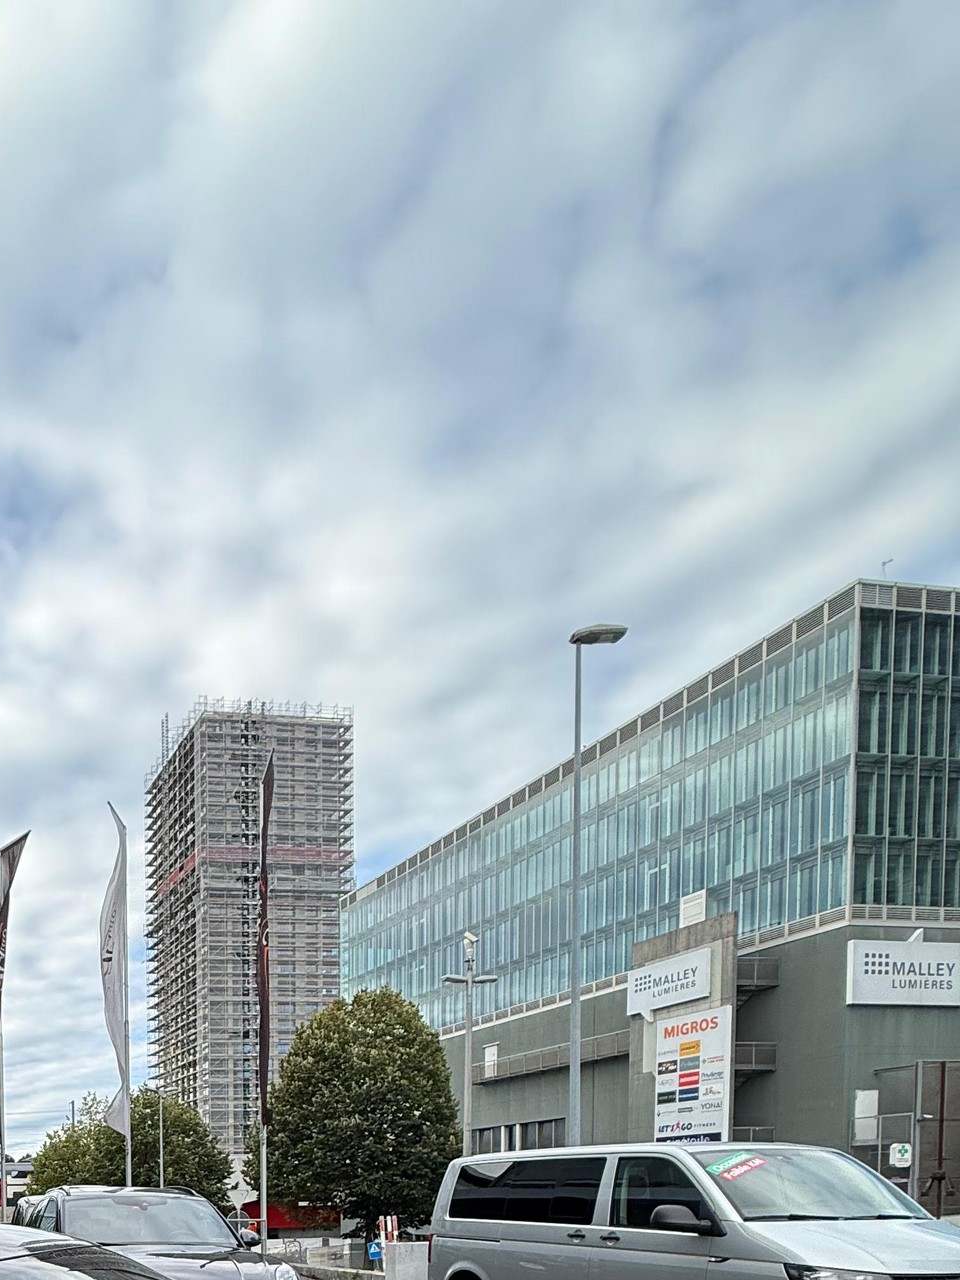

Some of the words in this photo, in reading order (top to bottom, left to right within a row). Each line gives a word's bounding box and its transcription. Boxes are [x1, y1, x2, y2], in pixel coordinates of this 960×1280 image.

[652, 966, 698, 988] MALLEY
[892, 961, 955, 976] MALLEY
[664, 1016, 719, 1039] MIGROS
